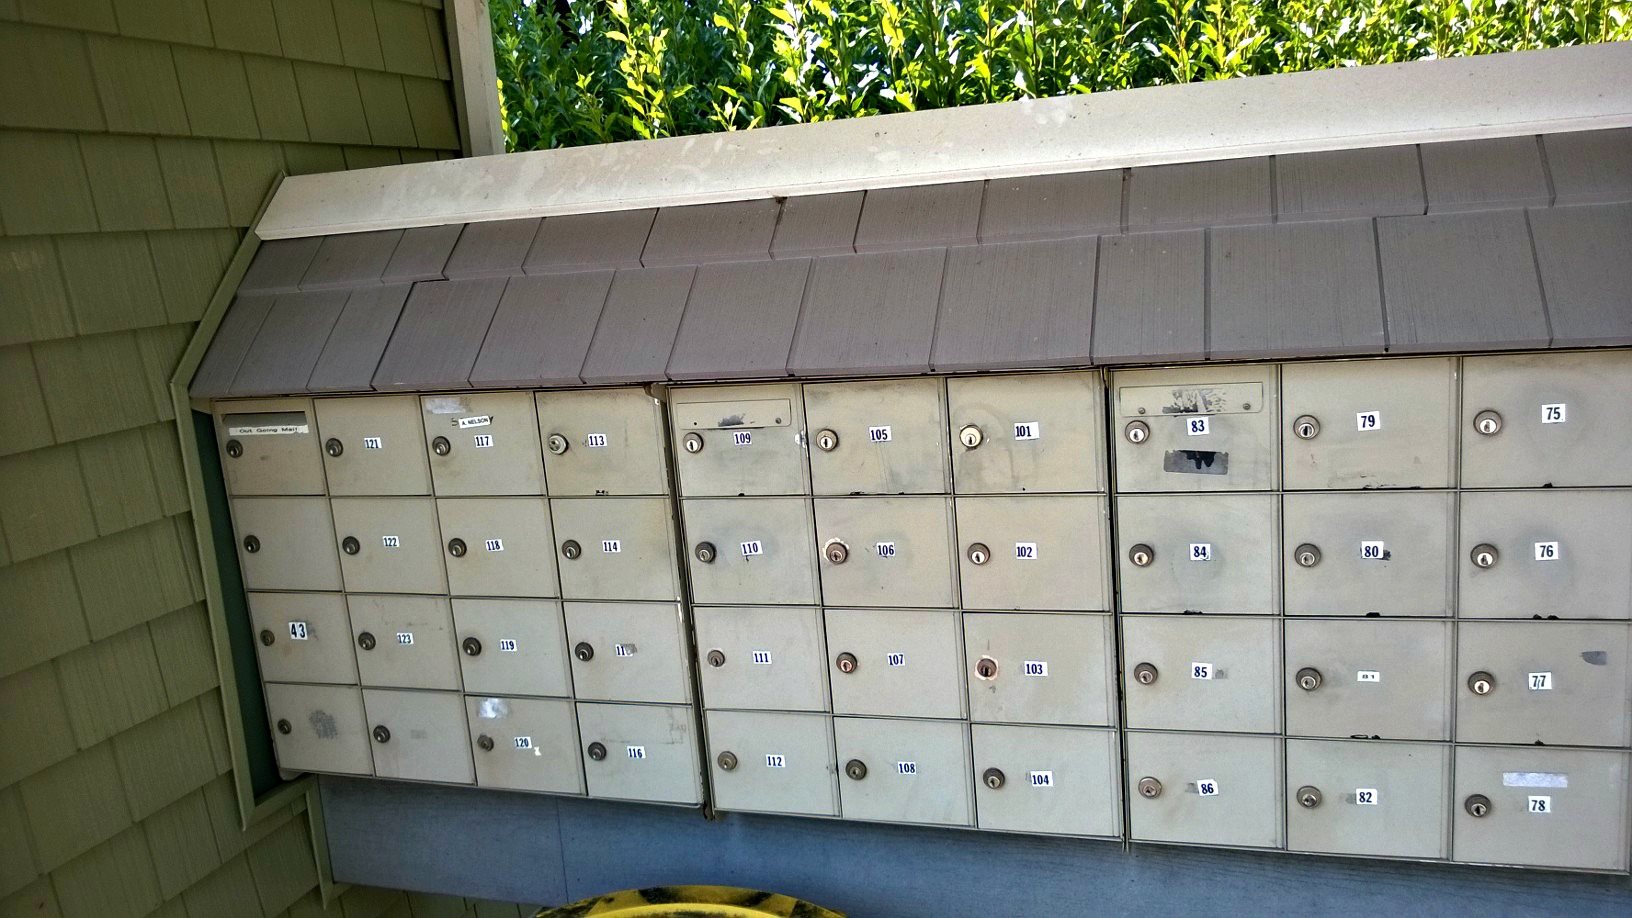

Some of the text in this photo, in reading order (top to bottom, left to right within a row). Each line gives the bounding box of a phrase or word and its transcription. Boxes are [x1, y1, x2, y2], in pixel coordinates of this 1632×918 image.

[1546, 407, 1561, 420] 75
[1192, 420, 1205, 432] 83
[1361, 416, 1375, 428] 79
[871, 429, 888, 440] 105
[1016, 425, 1031, 437] 101
[365, 439, 378, 448] 121
[476, 436, 489, 446] 117
[589, 436, 604, 445] 113
[735, 434, 751, 444] 109
[384, 537, 397, 547] 122
[487, 540, 500, 550] 118
[604, 542, 618, 552] 114
[742, 543, 759, 554] 110
[878, 544, 894, 556] 106
[1017, 547, 1032, 557] 102
[1194, 546, 1207, 558] 84
[1365, 546, 1378, 557] 80
[1540, 545, 1553, 557] 76
[398, 634, 411, 643] 123
[502, 640, 514, 650] 119
[754, 653, 768, 662] 111
[888, 654, 903, 665] 107
[1026, 664, 1043, 674] 103
[1194, 667, 1207, 678] 85
[1532, 675, 1546, 687] 77
[516, 738, 528, 747] 120
[629, 748, 642, 758] 116
[768, 756, 782, 766] 112
[899, 763, 915, 773] 108
[1032, 775, 1049, 785] 104
[1201, 783, 1214, 794] 86
[1360, 792, 1372, 802] 82
[1532, 800, 1545, 811] 78
